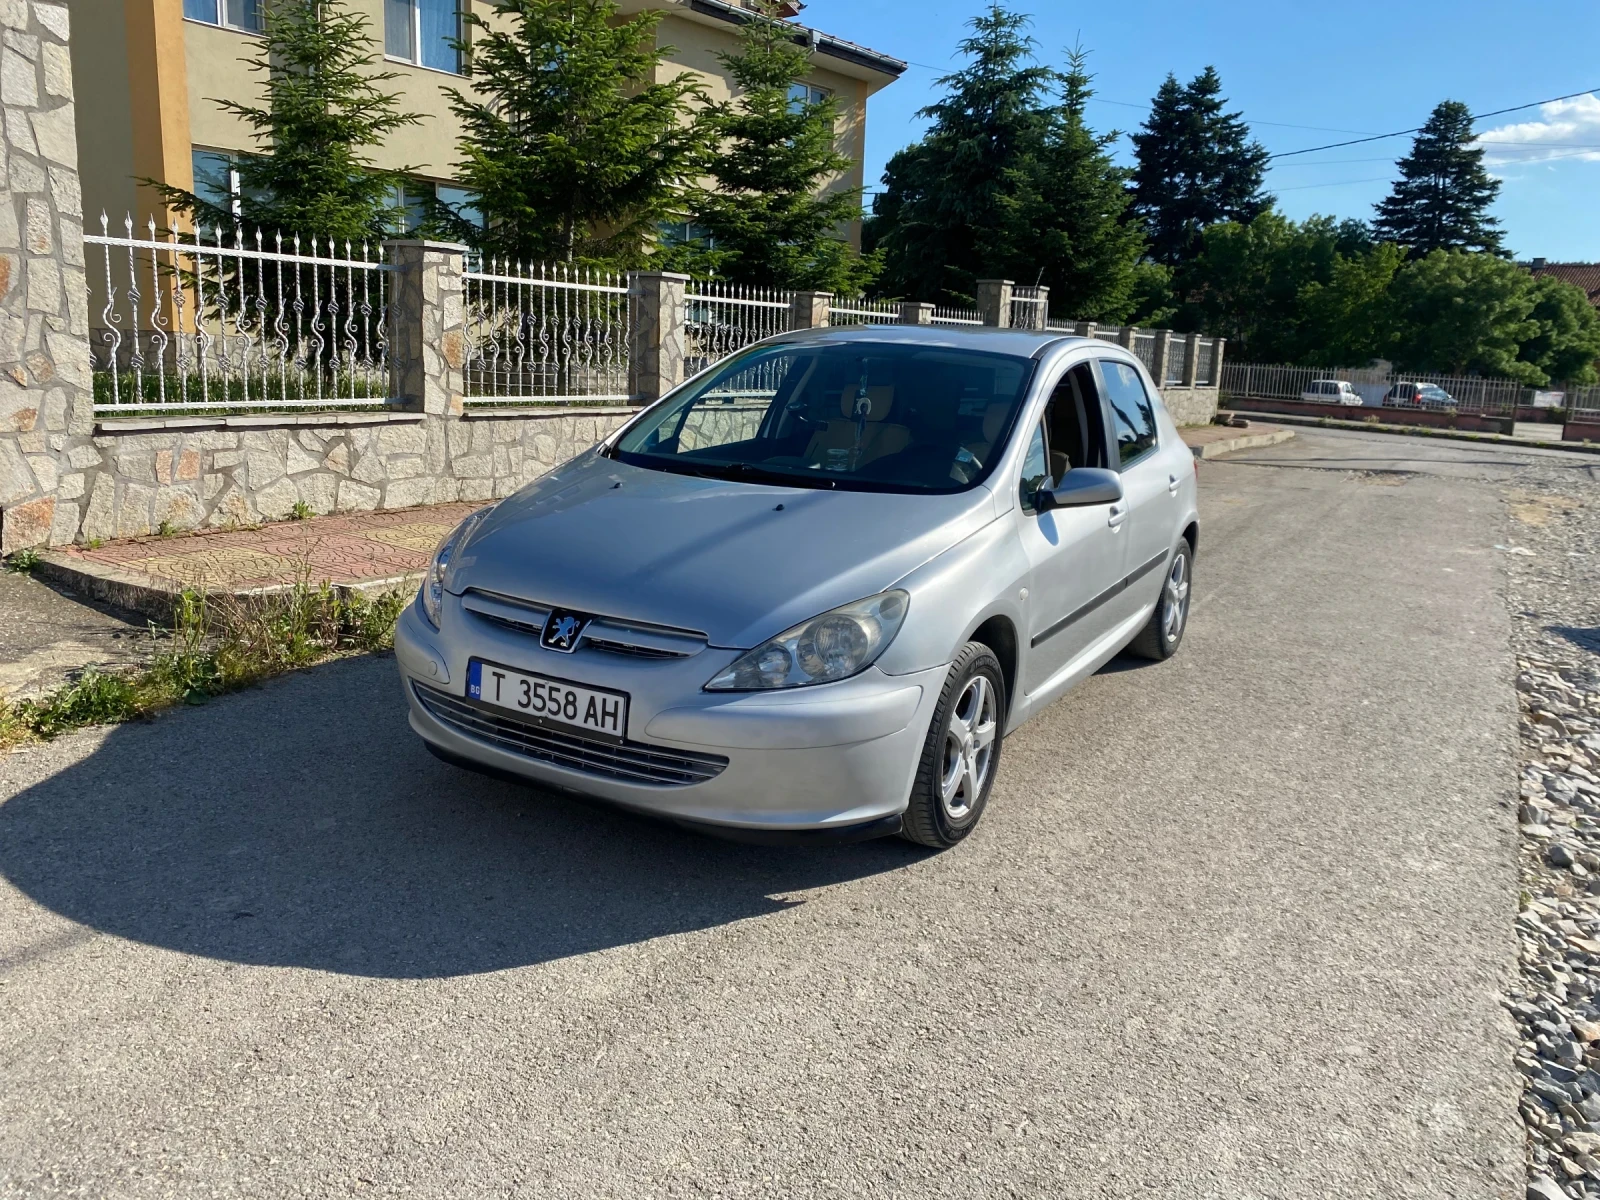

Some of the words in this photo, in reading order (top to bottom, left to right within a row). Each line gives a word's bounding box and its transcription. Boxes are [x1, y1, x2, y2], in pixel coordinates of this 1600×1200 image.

[471, 684, 480, 695] BG
[492, 671, 505, 701] T
[518, 679, 577, 720] 3558
[584, 696, 619, 731] AH
